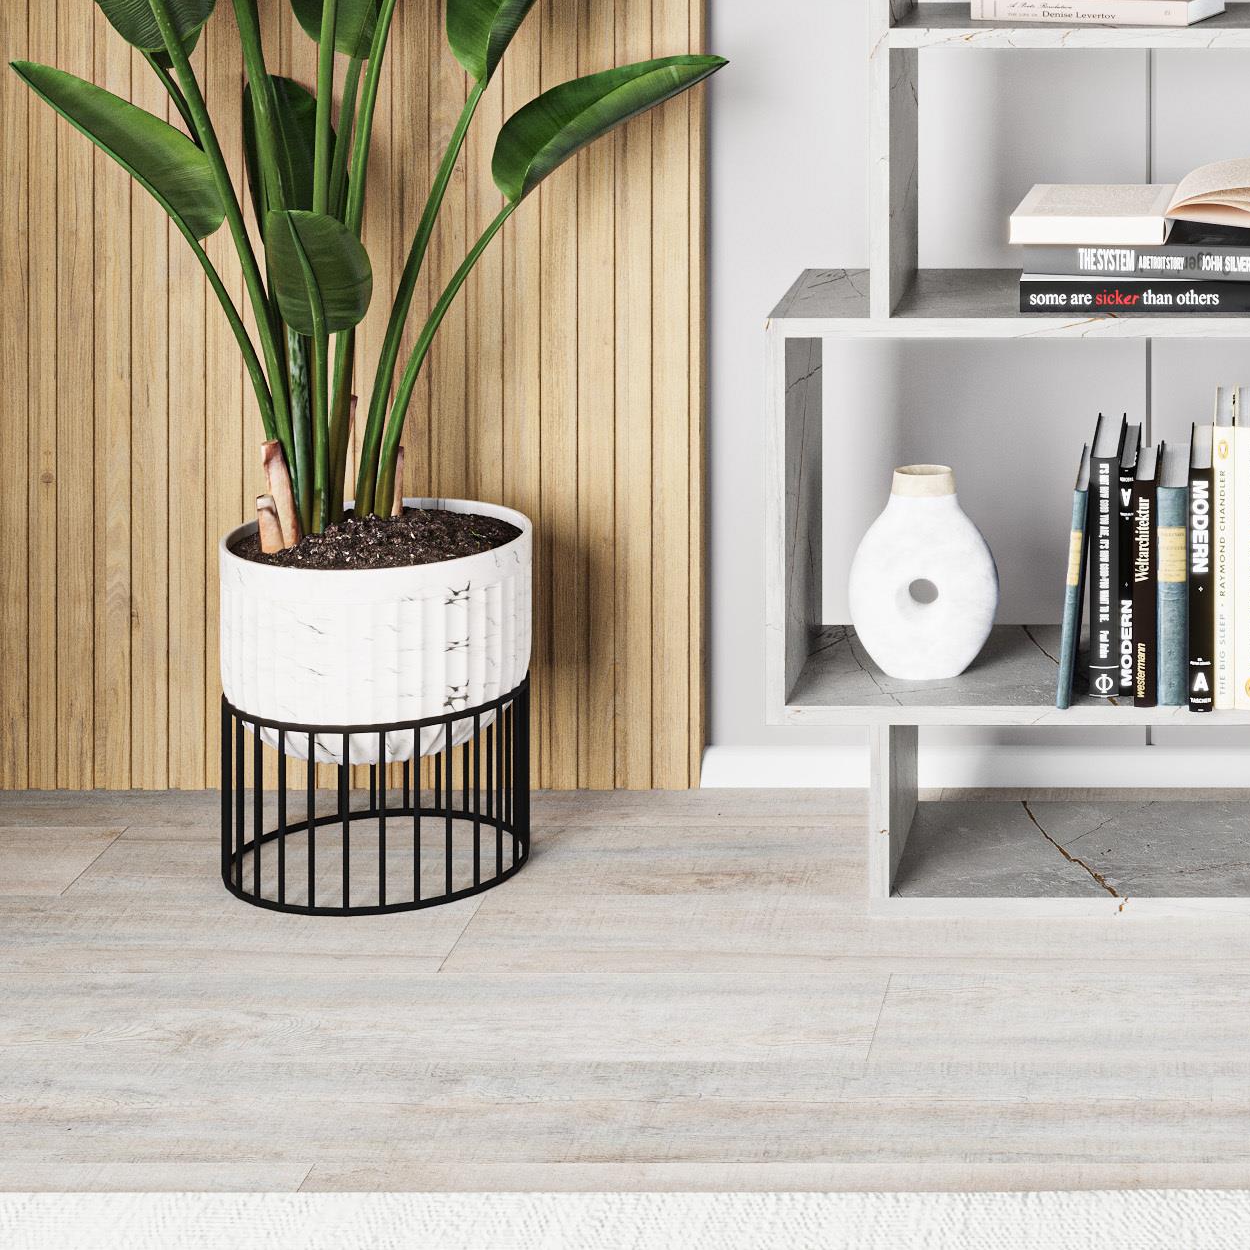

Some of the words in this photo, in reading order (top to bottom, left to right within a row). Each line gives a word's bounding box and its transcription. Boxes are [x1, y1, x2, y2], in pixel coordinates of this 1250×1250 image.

[1042, 10, 1073, 19] Denise
[1076, 11, 1116, 20] Levertov
[1078, 248, 1096, 270] THE
[1096, 248, 1135, 271] SYSTEM
[1202, 256, 1223, 272] JOHN
[1029, 292, 1067, 305] some
[1070, 292, 1092, 305] are
[1095, 289, 1140, 305] sicker
[1143, 290, 1172, 305] than
[1176, 290, 1220, 305] others
[1135, 496, 1150, 583] Weltarchitektur
[1192, 480, 1209, 574] MODERN
[1120, 599, 1133, 687] MODERN
[1136, 643, 1147, 699] westermann
